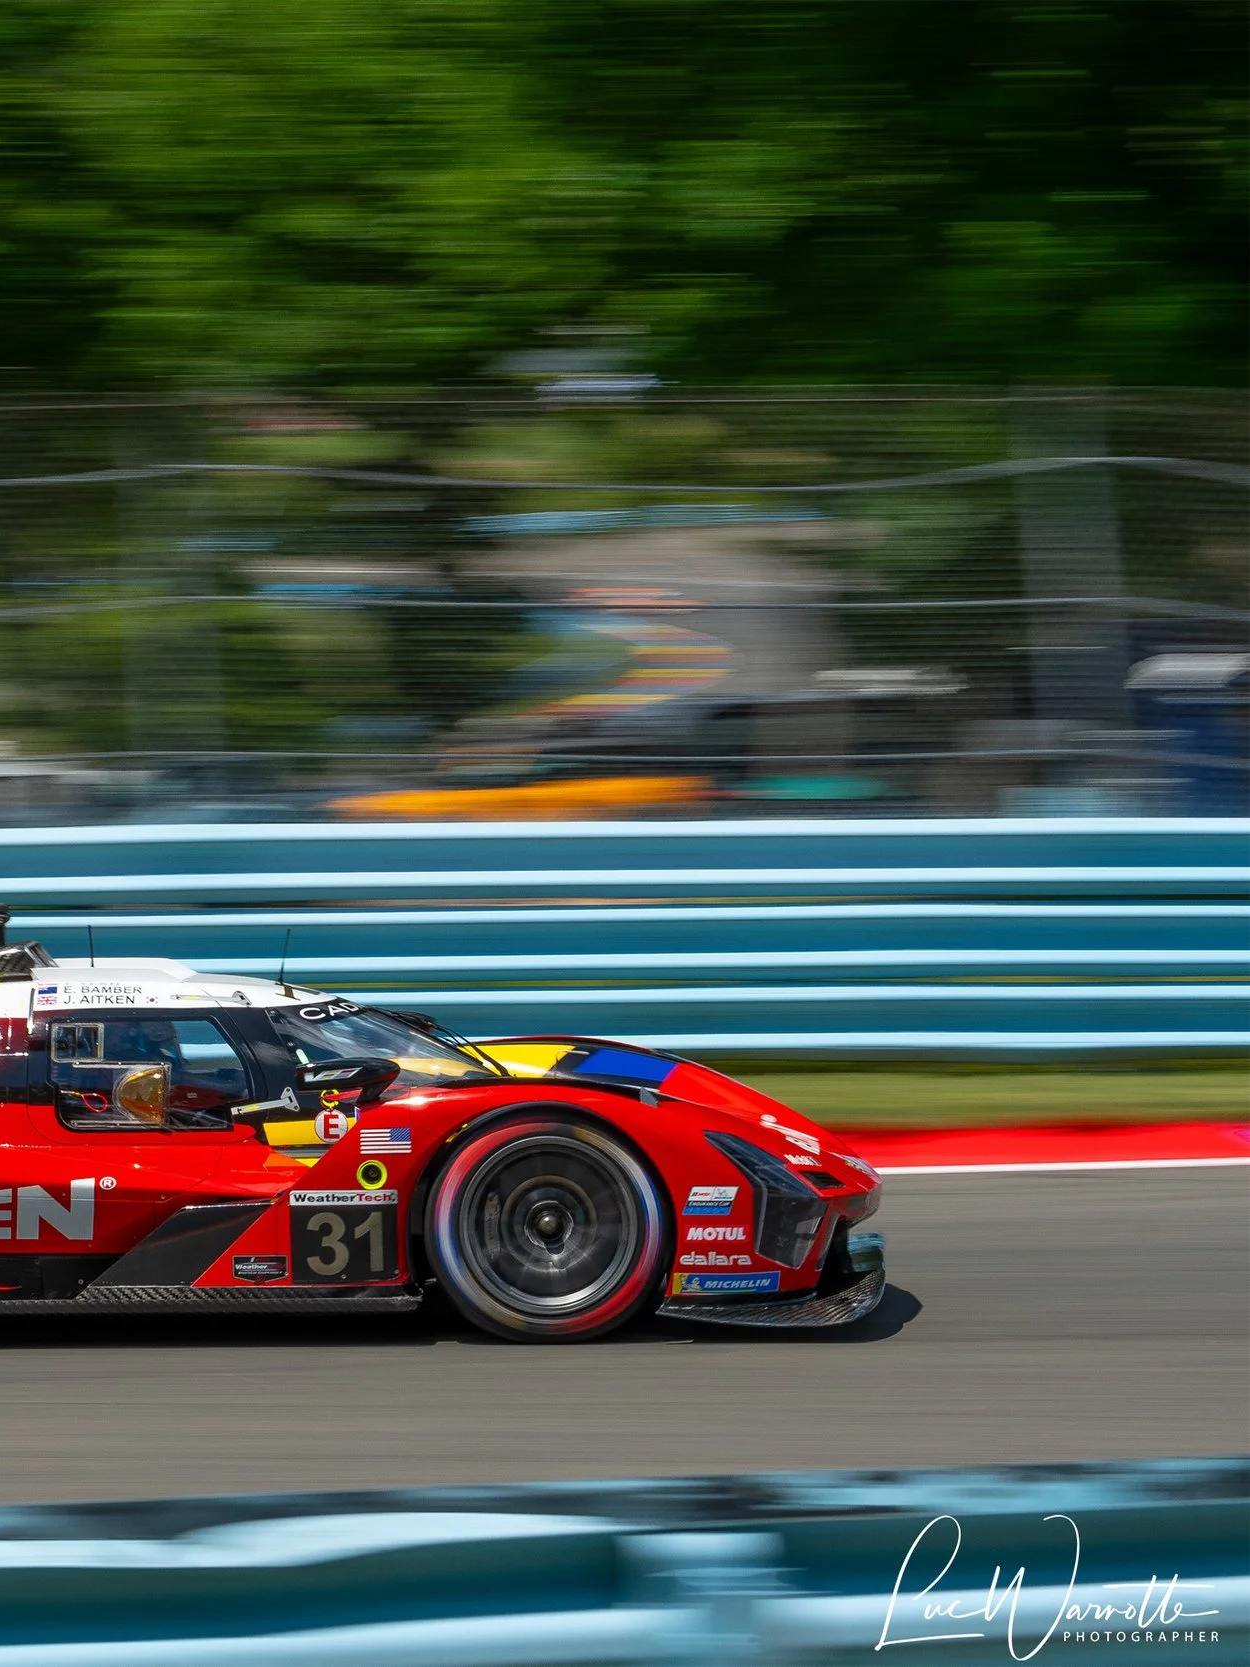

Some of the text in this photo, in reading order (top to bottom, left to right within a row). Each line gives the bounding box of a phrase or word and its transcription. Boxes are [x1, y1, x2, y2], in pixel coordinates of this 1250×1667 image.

[63, 986, 142, 994] E. BAMBER
[63, 995, 135, 1004] J. AITKEN
[323, 1114, 340, 1139] E
[293, 1193, 392, 1203] WeatherTech
[686, 1227, 747, 1241] MOTUL
[306, 1211, 385, 1276] 31
[679, 1251, 752, 1266] dallara
[704, 1278, 772, 1289] MICHELIN
